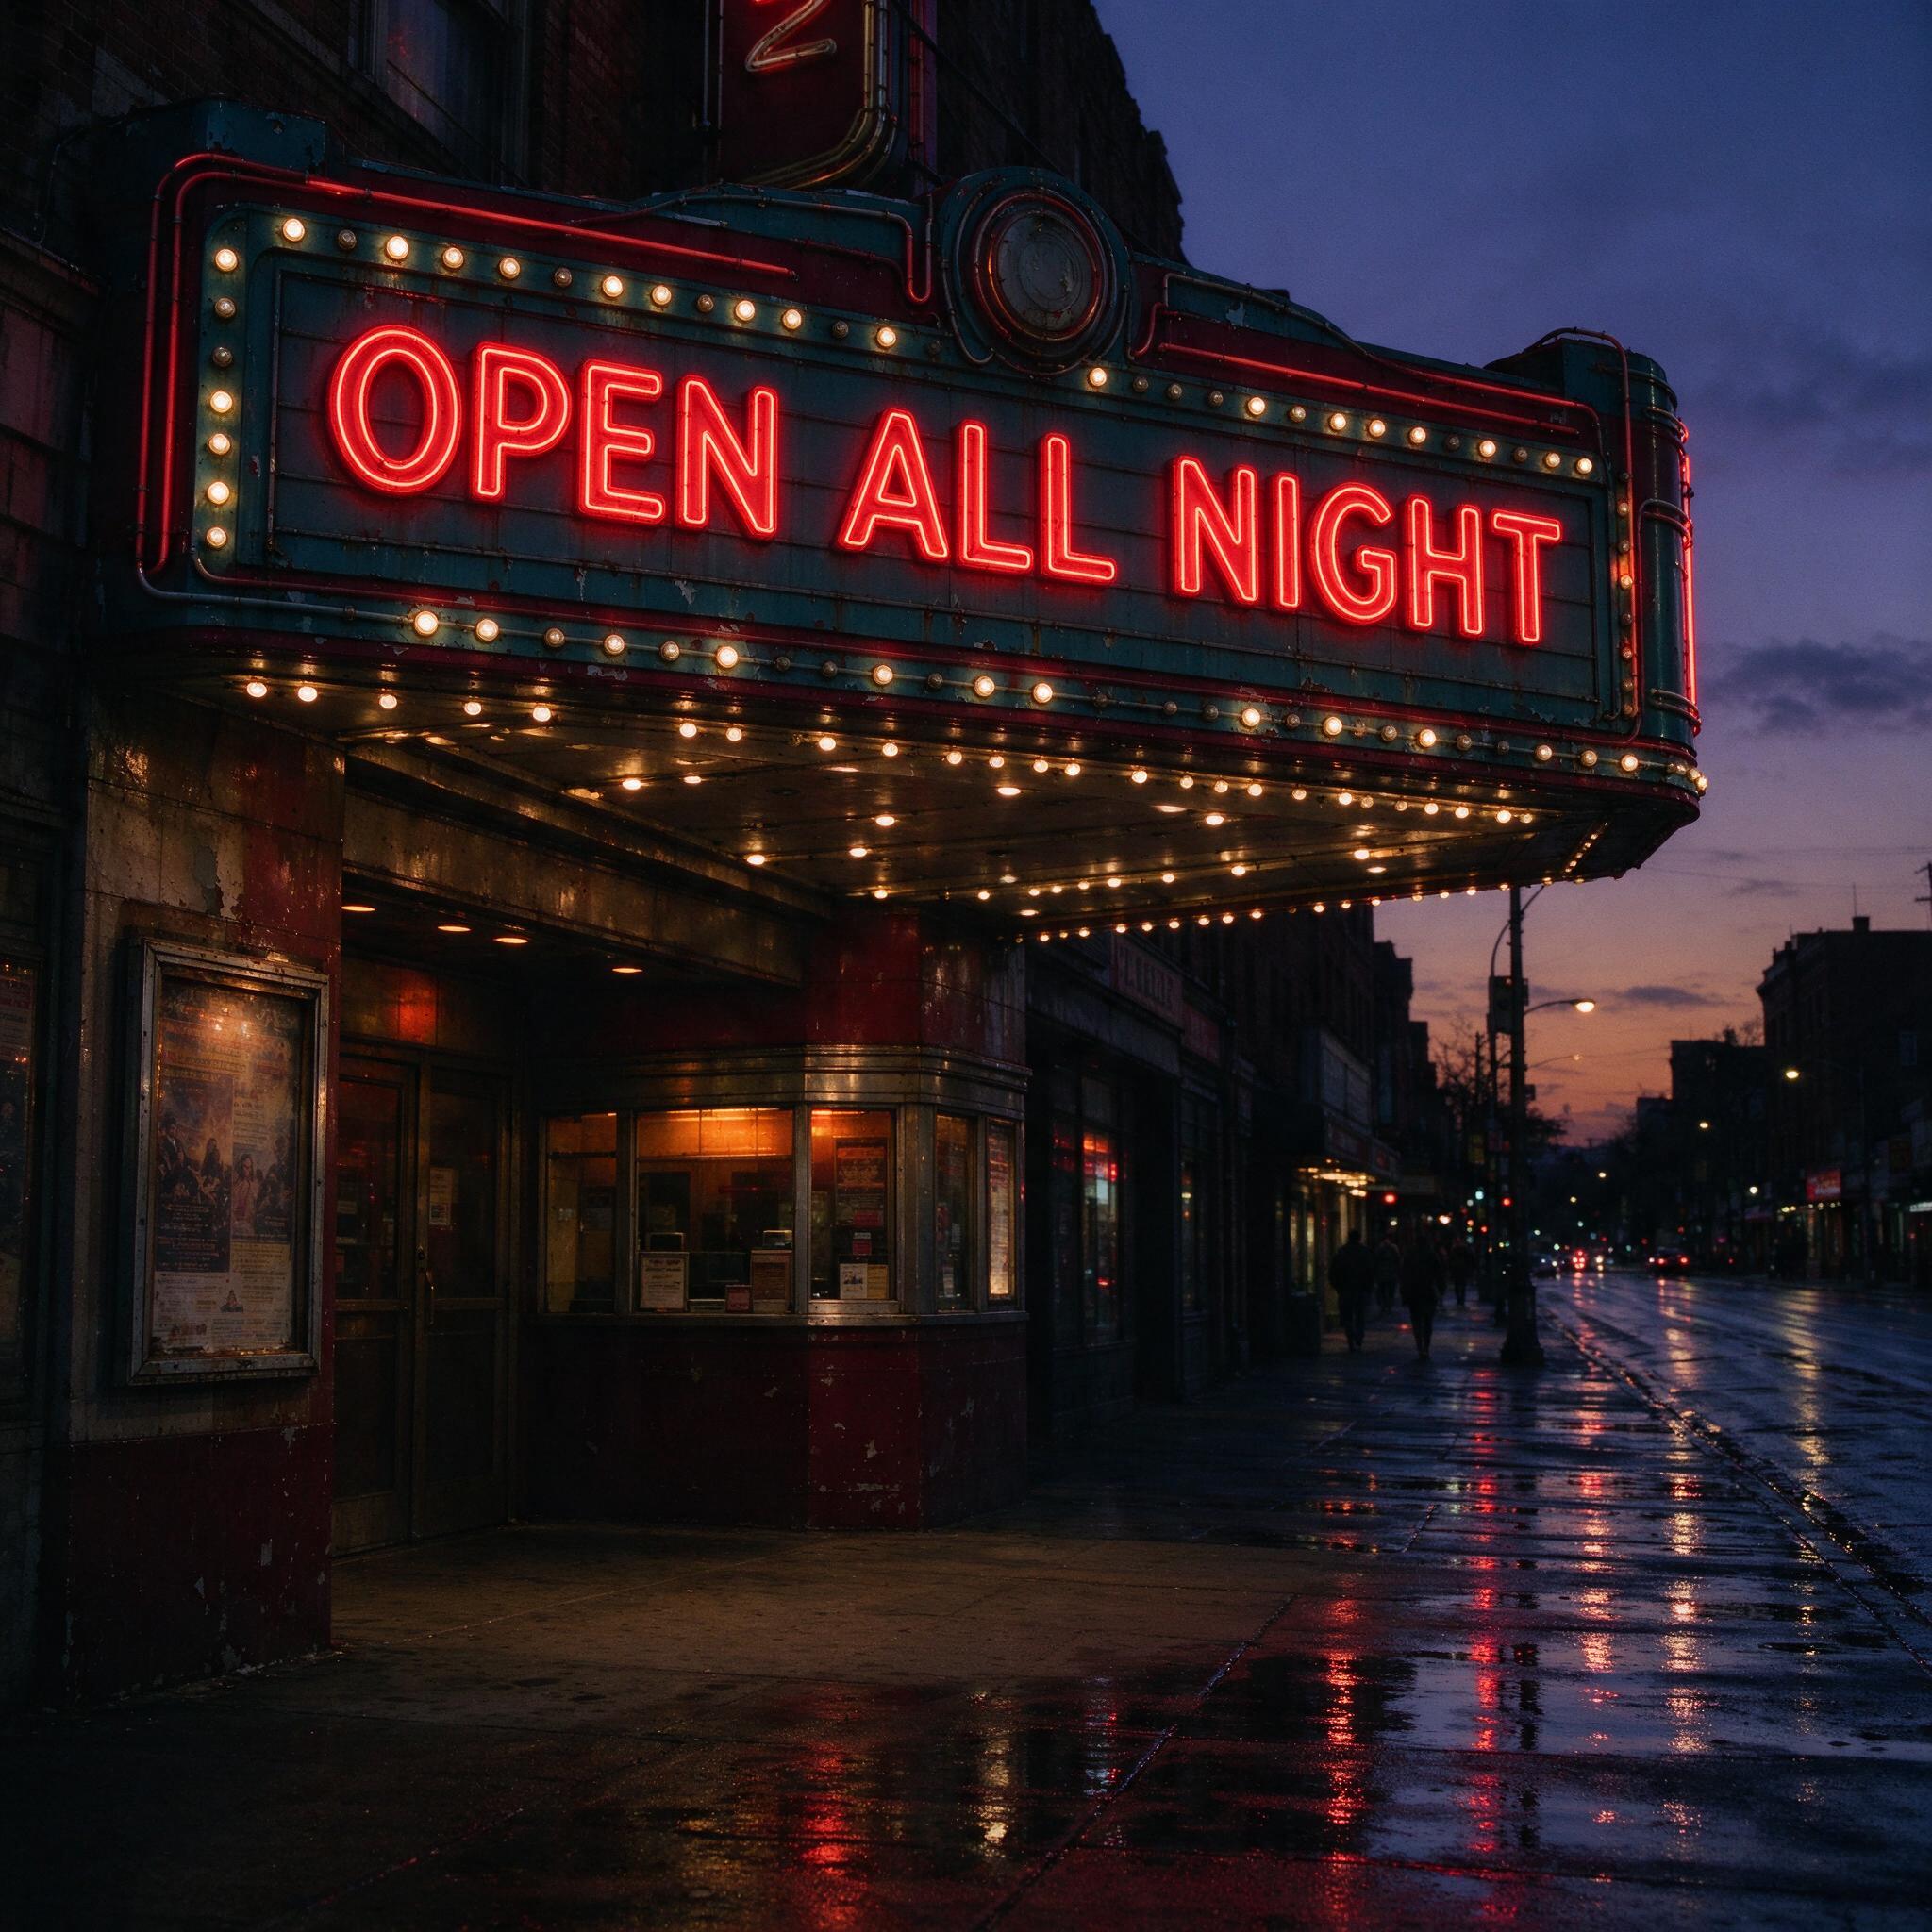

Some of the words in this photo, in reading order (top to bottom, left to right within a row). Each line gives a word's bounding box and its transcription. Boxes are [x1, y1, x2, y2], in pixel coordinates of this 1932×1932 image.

[327, 325, 780, 541] OPEN
[840, 408, 1119, 586] ALL
[1172, 454, 1563, 645] NIGHT
